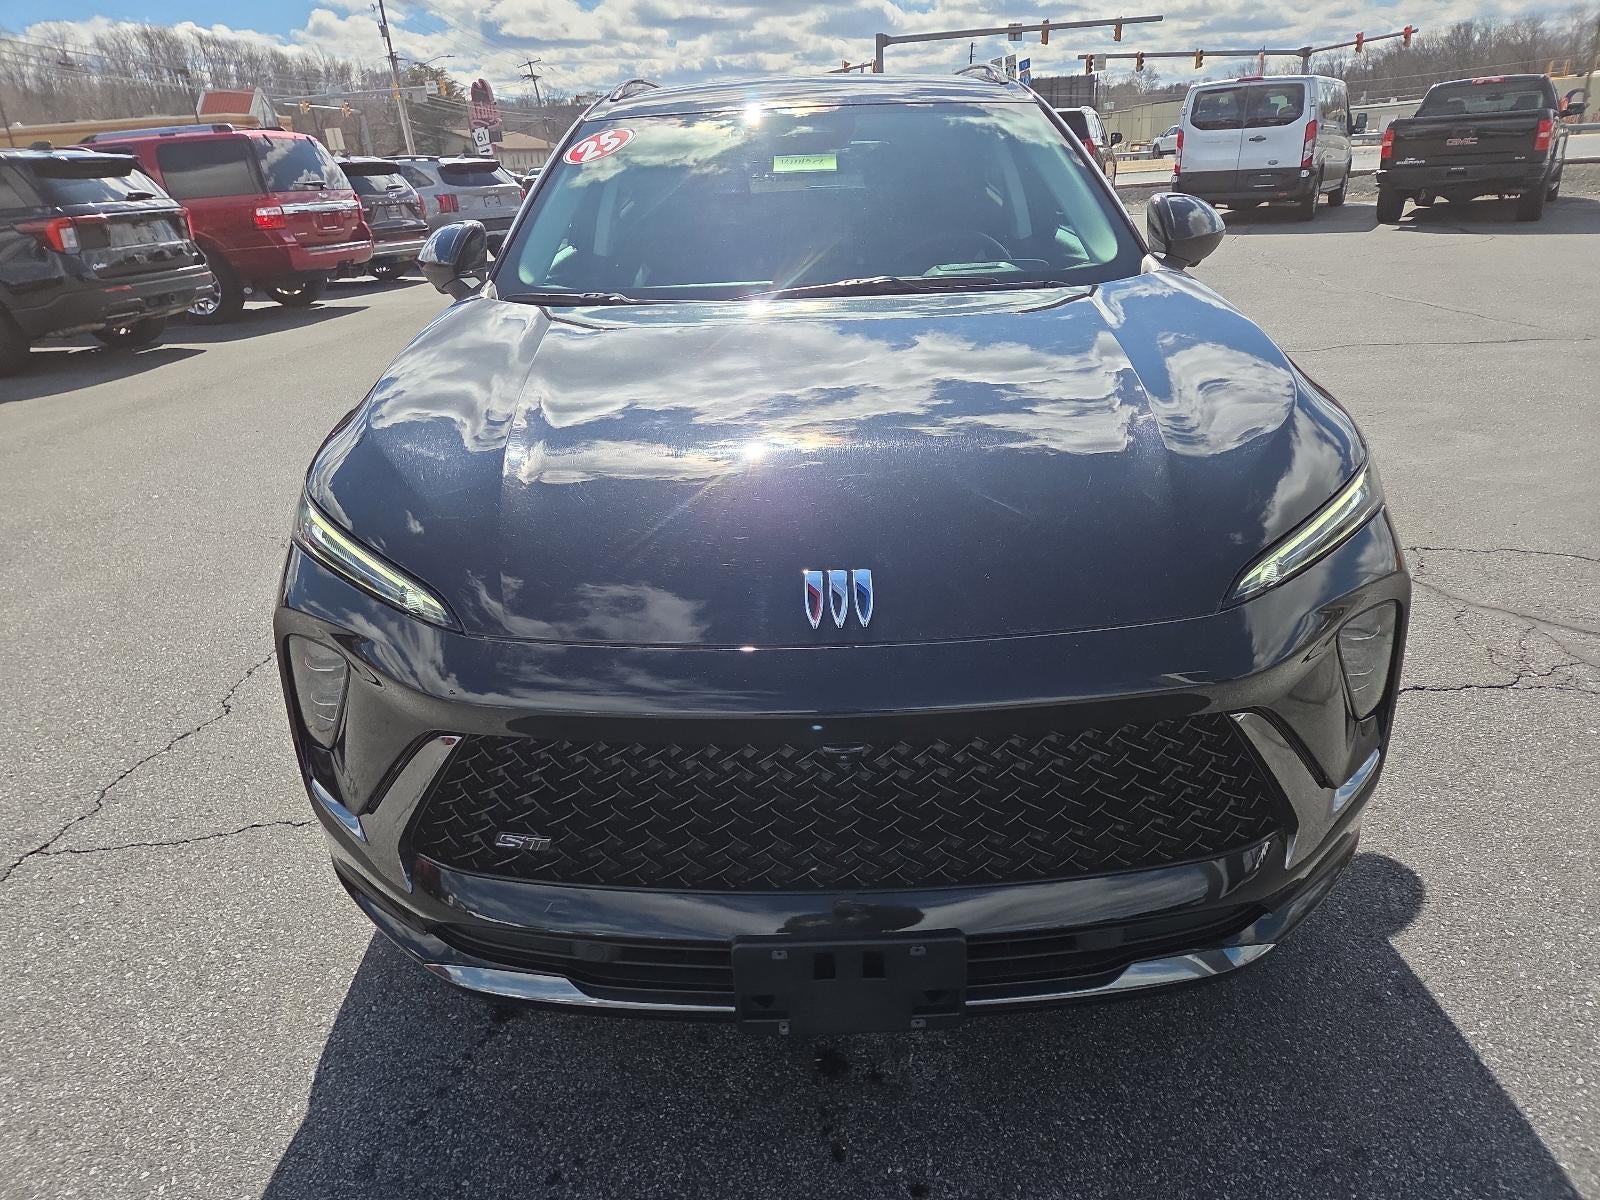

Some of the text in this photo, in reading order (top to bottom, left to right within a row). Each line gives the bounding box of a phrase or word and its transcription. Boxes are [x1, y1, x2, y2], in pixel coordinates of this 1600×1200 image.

[477, 131, 487, 142] 61
[1446, 137, 1479, 146] GMC
[577, 130, 621, 161] 25
